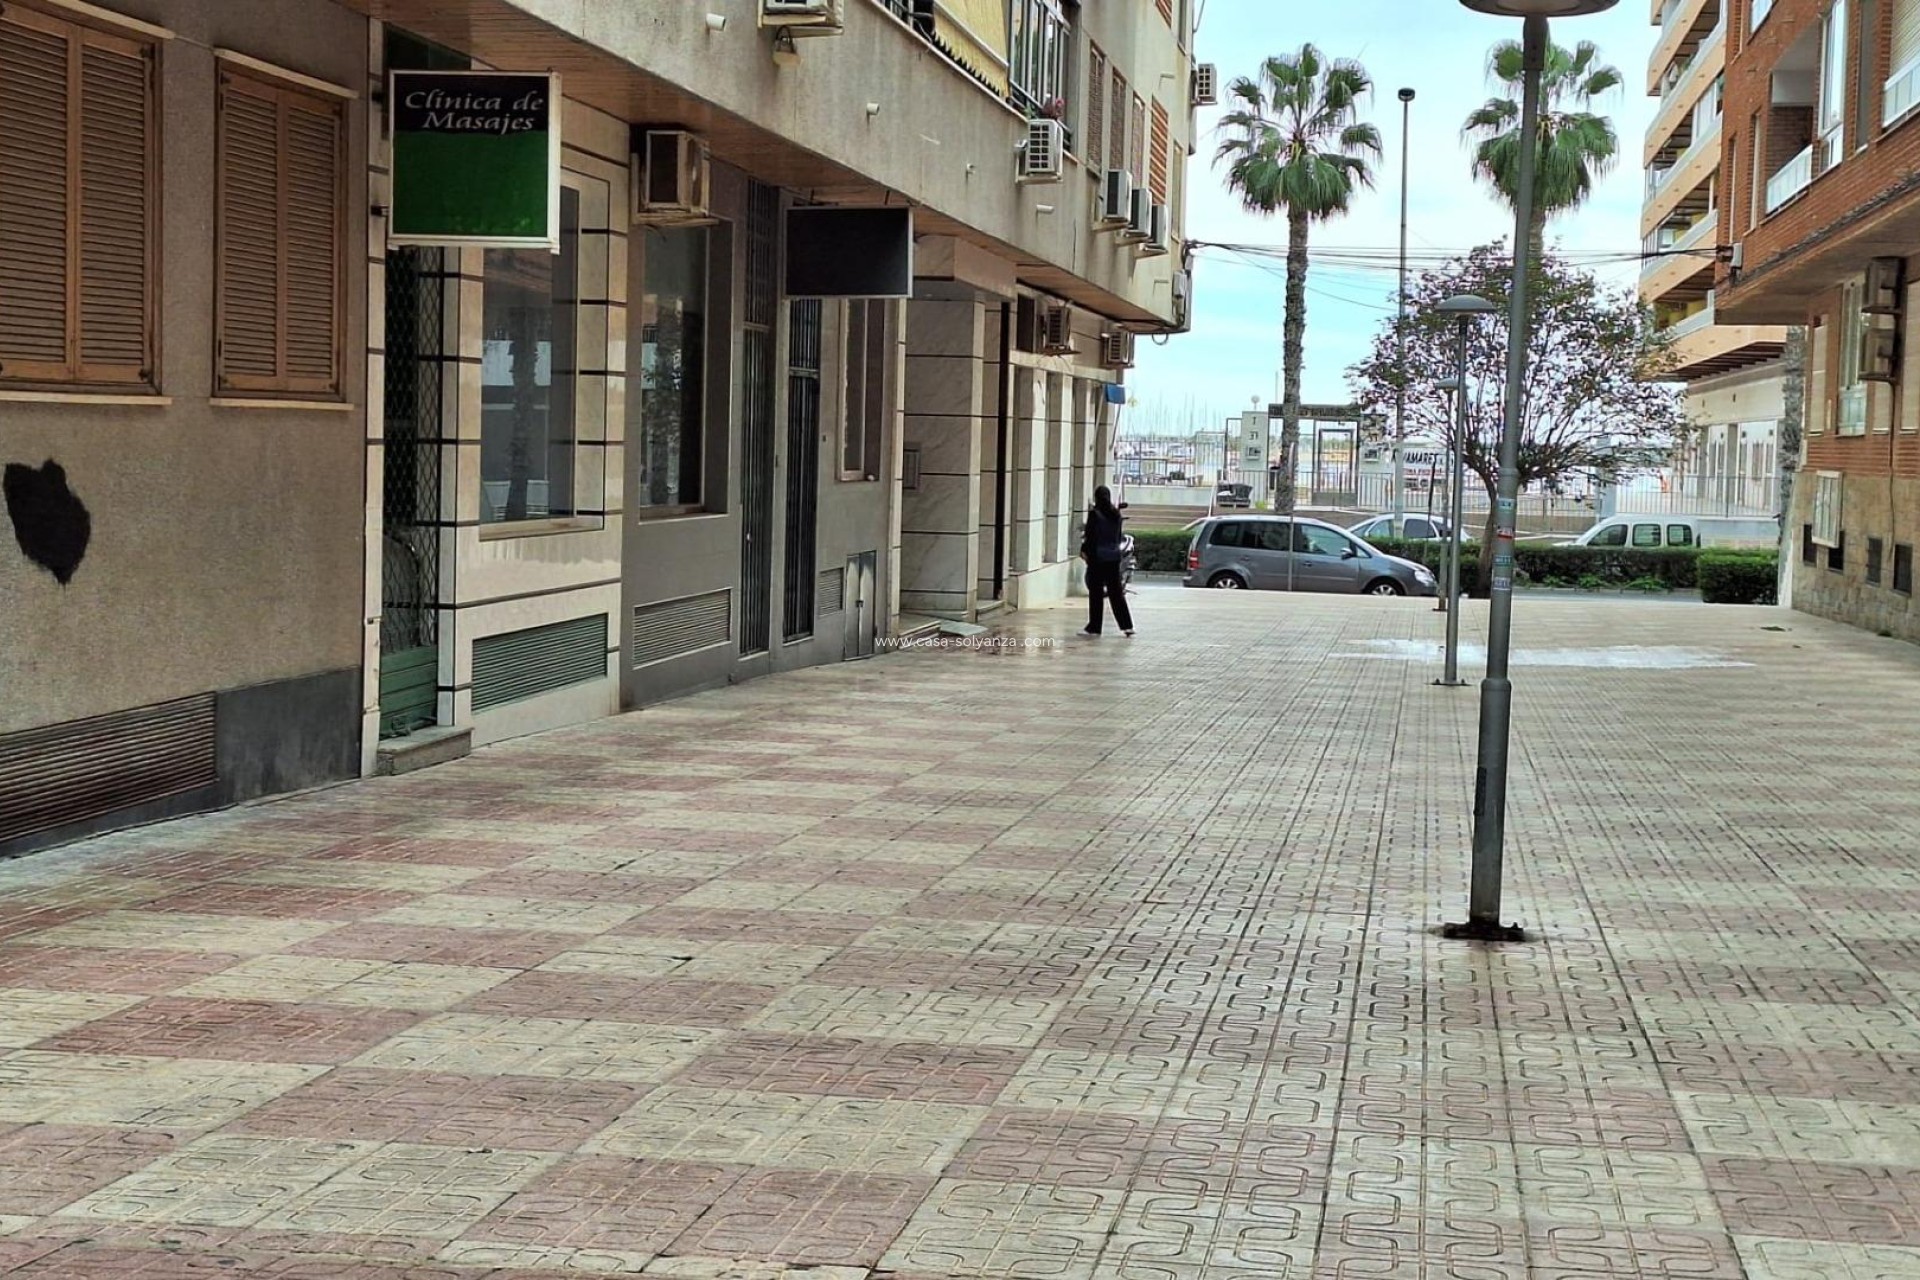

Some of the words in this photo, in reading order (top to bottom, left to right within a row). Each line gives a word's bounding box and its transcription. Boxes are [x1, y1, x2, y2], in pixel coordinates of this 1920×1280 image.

[405, 88, 501, 110] Clínica
[512, 90, 544, 110] de
[422, 111, 535, 135] Masajes
